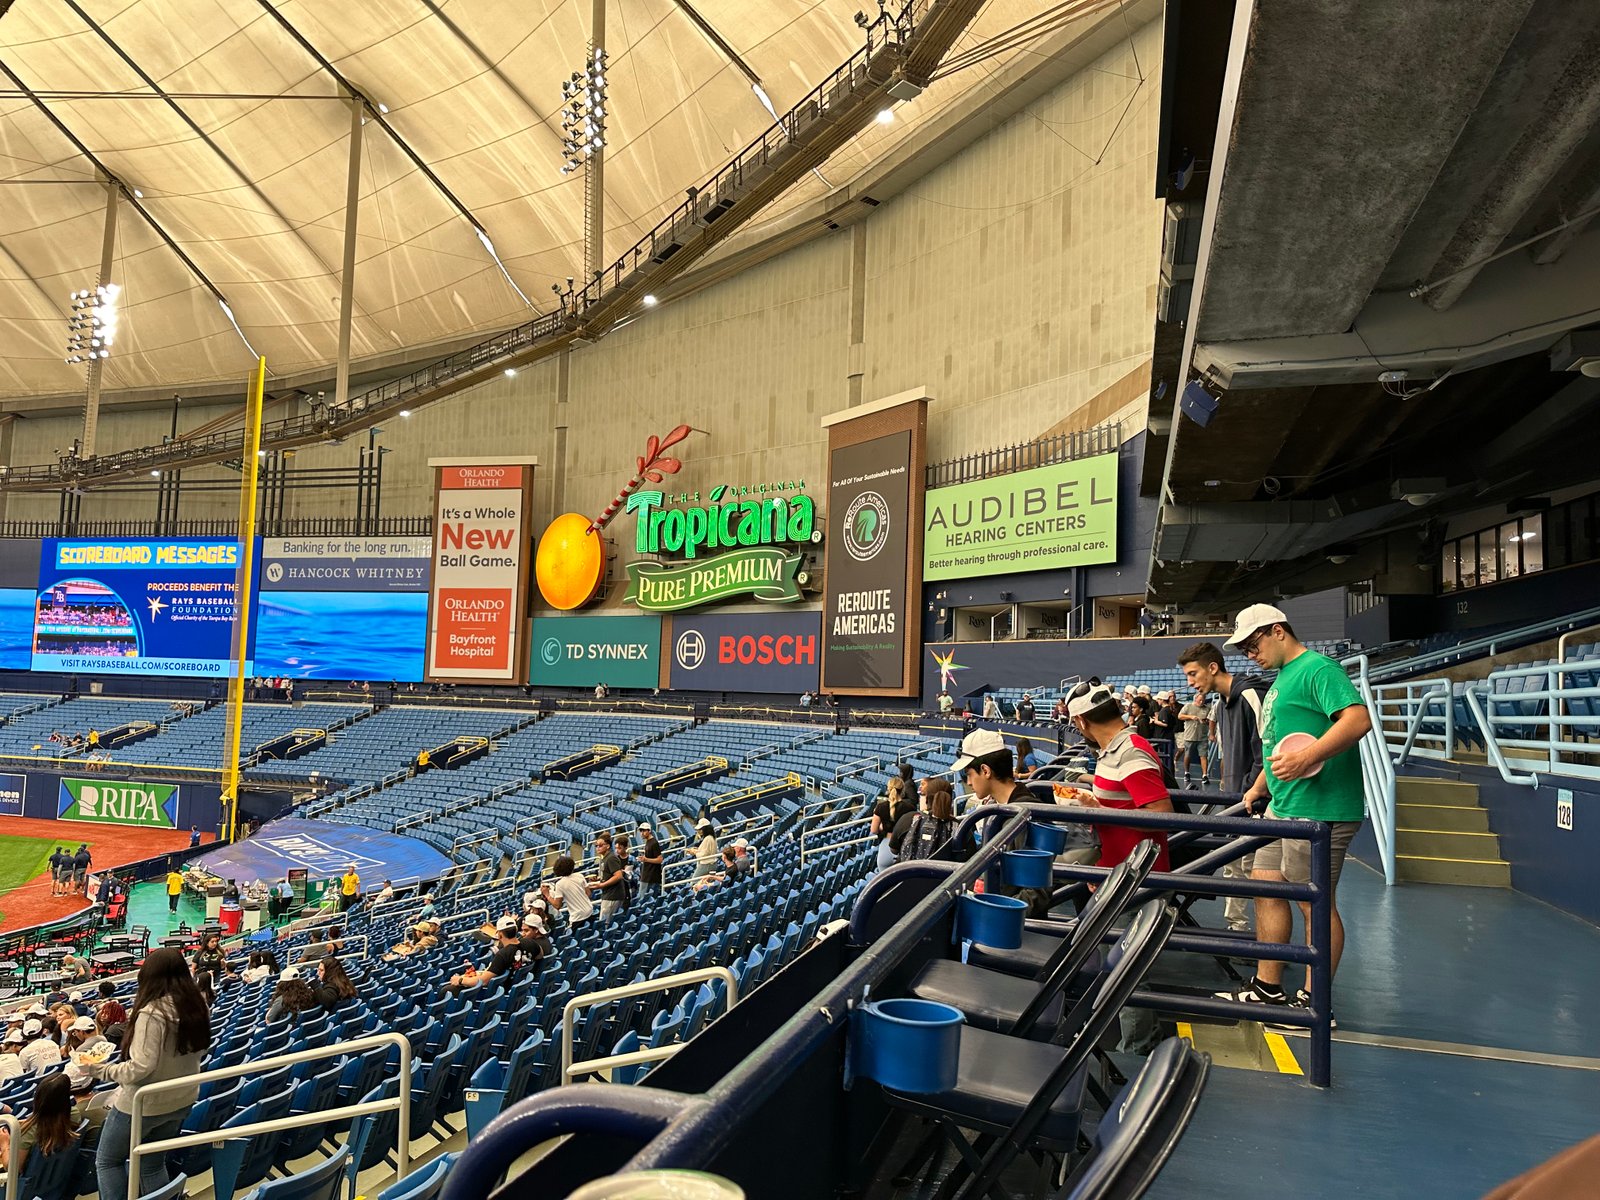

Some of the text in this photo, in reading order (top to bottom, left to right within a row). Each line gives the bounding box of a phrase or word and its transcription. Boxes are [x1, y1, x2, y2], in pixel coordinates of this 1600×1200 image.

[460, 468, 504, 478] ORLANDO
[864, 469, 889, 480] Sustainable
[464, 478, 500, 487] HEALTH
[668, 479, 805, 504] THE ORIGINAL
[928, 477, 1113, 532] AUDIBEL
[442, 507, 516, 519] It's a Whole
[845, 494, 887, 529] ReRoute Americas
[626, 491, 814, 559] Tropicana
[946, 514, 1086, 547] HEARING CENTERS
[441, 522, 515, 550] New
[283, 541, 411, 554] Banking for the long run.
[60, 546, 237, 564] SCOREBOARD MESSAGES
[440, 554, 516, 567] Ball Game.
[929, 540, 1108, 569] Better hearing through professional care.
[288, 568, 424, 578] HANCOCK WHITNEY
[638, 576, 686, 603] PURE
[690, 557, 784, 597] PREMIUM
[147, 583, 240, 591] PROCEEDS BENEFIT THE
[55, 590, 64, 602] TB
[172, 597, 193, 605] RAYS
[838, 589, 891, 613] REROUTE
[444, 598, 504, 610] ORLANDO
[1457, 601, 1468, 614] 132
[451, 610, 496, 622] HEALTH
[833, 612, 895, 635] AMERICAS
[449, 634, 496, 646] Bayfront
[450, 646, 494, 659] Hospital
[566, 644, 648, 660] TD SYNNEX
[718, 634, 815, 665] BOSCH
[61, 659, 220, 671] VISIT RAYSBASEBALL.COM/SCOREBOARD
[99, 787, 161, 821] RIPA
[1559, 805, 1571, 826] 128
